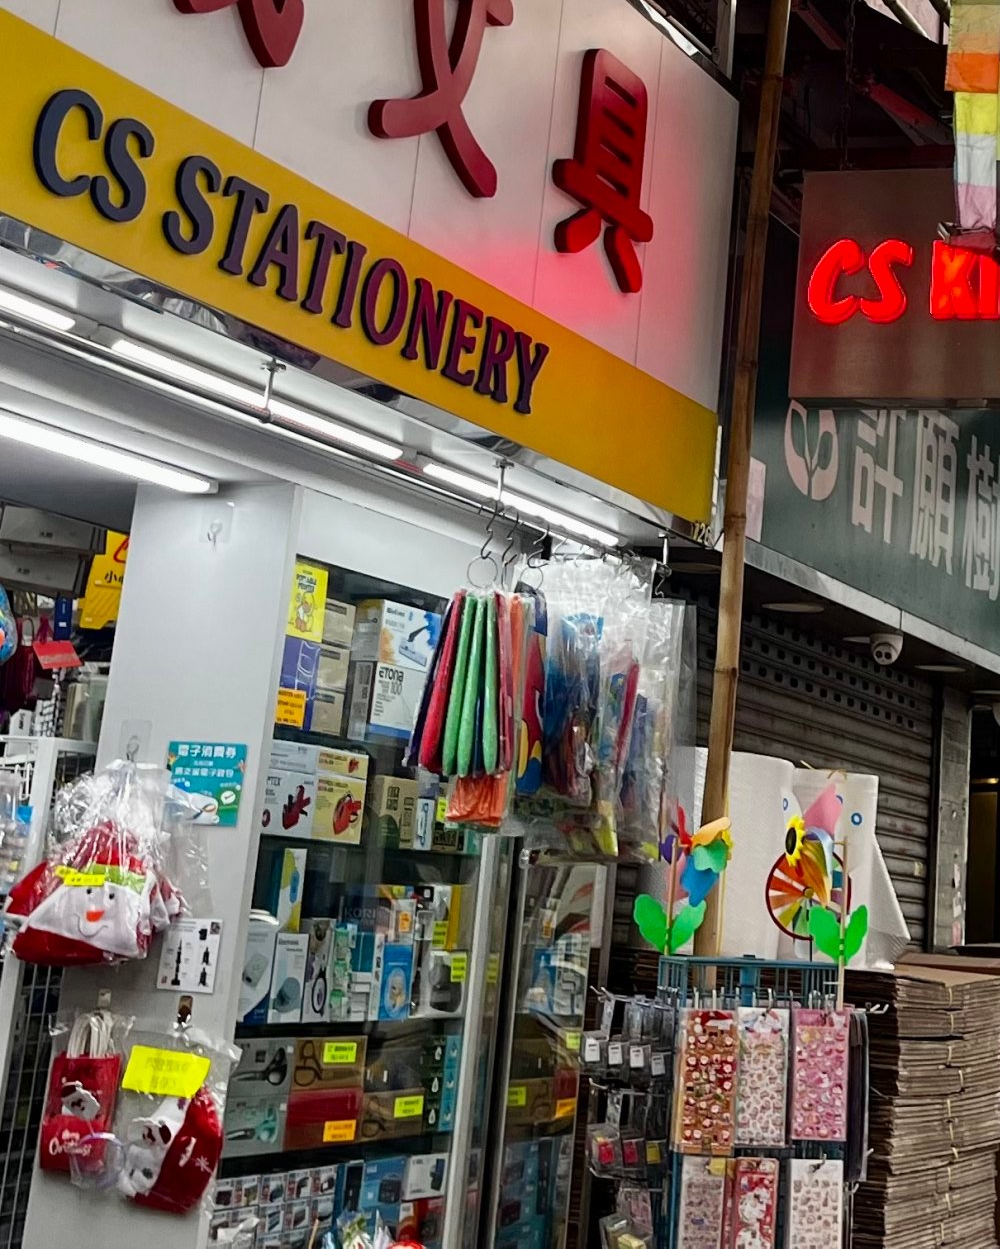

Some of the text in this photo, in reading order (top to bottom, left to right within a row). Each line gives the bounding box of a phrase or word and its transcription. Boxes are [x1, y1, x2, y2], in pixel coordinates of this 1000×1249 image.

[33, 89, 549, 414] CS STATIONERY
[808, 238, 913, 325] CS
